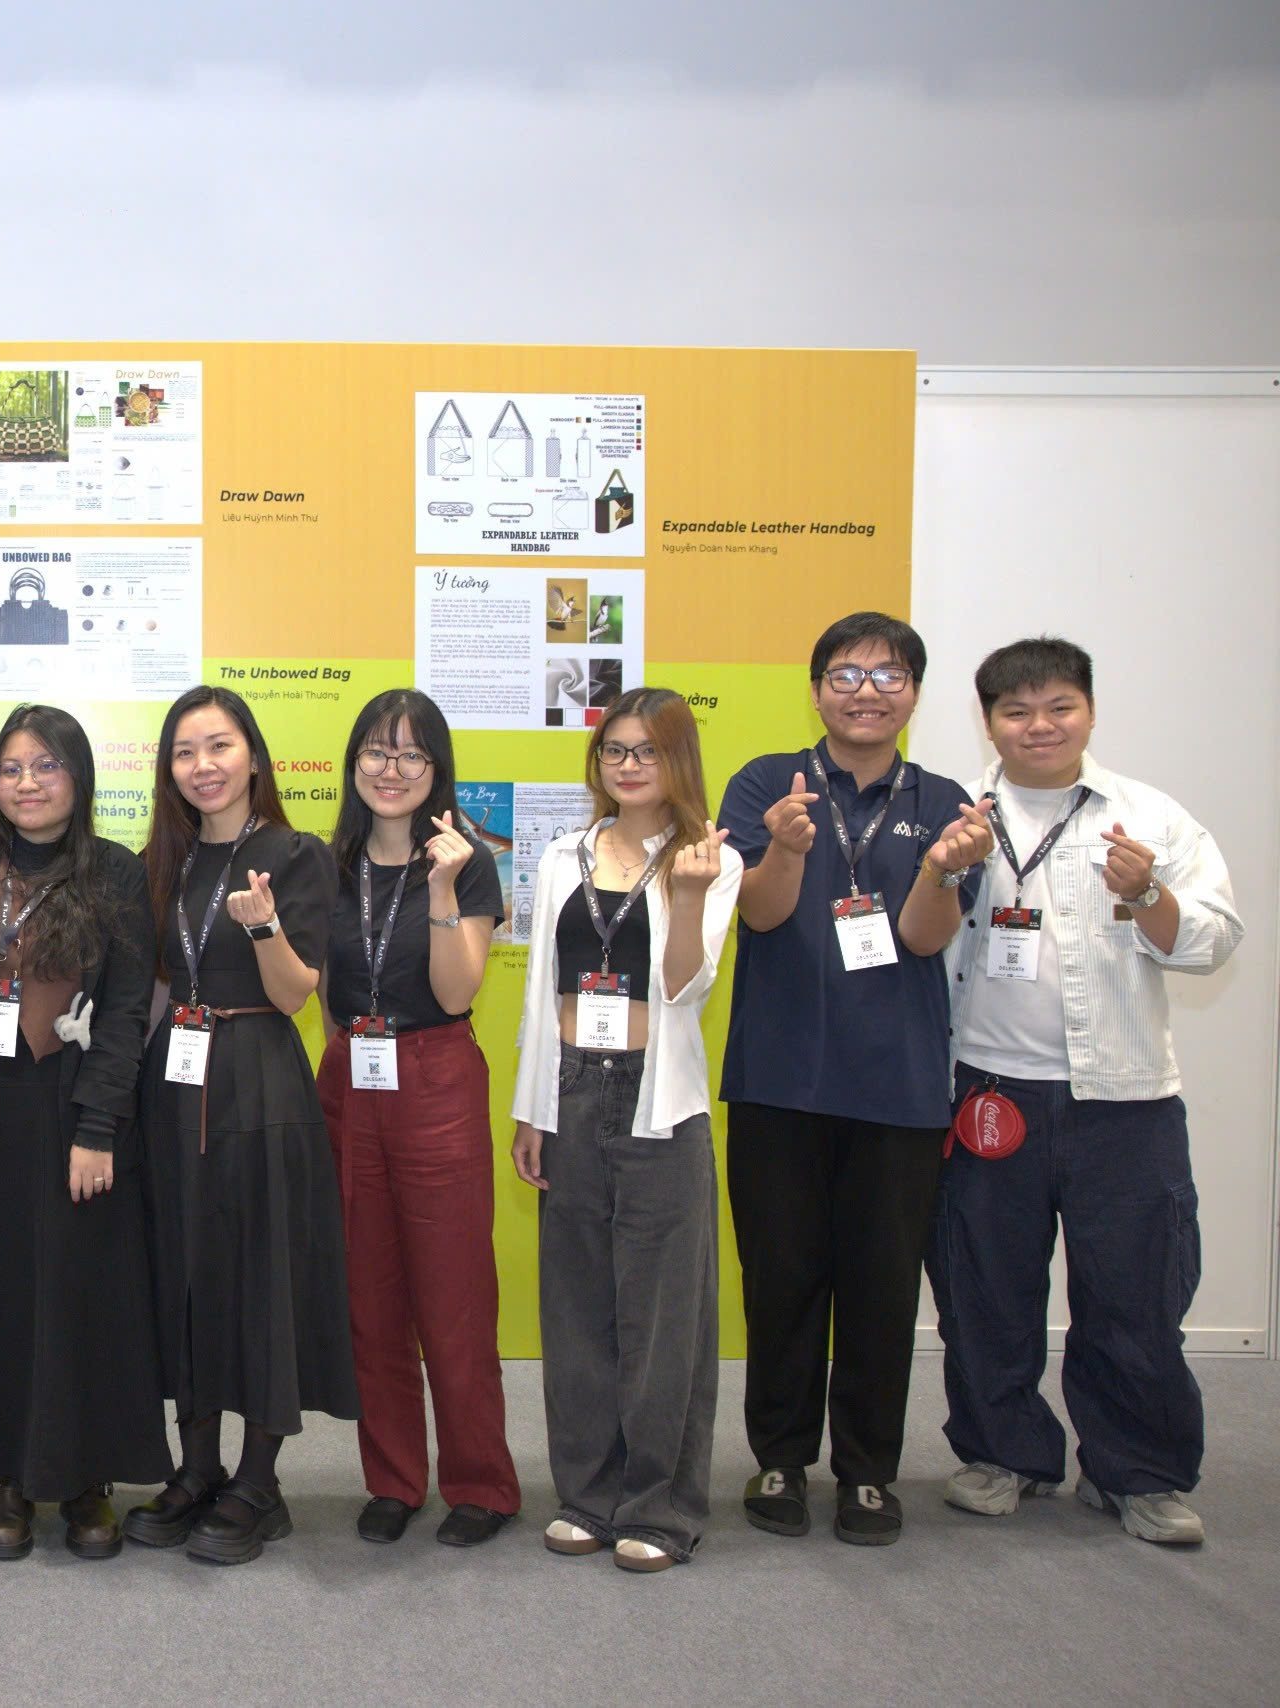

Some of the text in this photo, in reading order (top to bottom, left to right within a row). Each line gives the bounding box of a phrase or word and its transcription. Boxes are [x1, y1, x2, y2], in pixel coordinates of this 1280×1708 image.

[116, 369, 180, 379] Draw Dawn
[220, 490, 305, 502] Draw Dawn
[276, 513, 298, 522] Minh
[662, 520, 876, 537] Expandable Leather Handbag
[482, 530, 579, 540] EXPANDABLE LEATHER
[511, 543, 551, 552] HANDBAG
[725, 544, 747, 553] Nam
[749, 544, 778, 555] Khang
[2, 552, 50, 563] UNBOWED
[52, 552, 72, 563] BAG
[220, 667, 351, 682] The Unbowed Bag
[291, 760, 333, 773] KONG
[310, 787, 337, 801] Giải
[95, 804, 136, 819] tháng
[140, 805, 149, 817] 3
